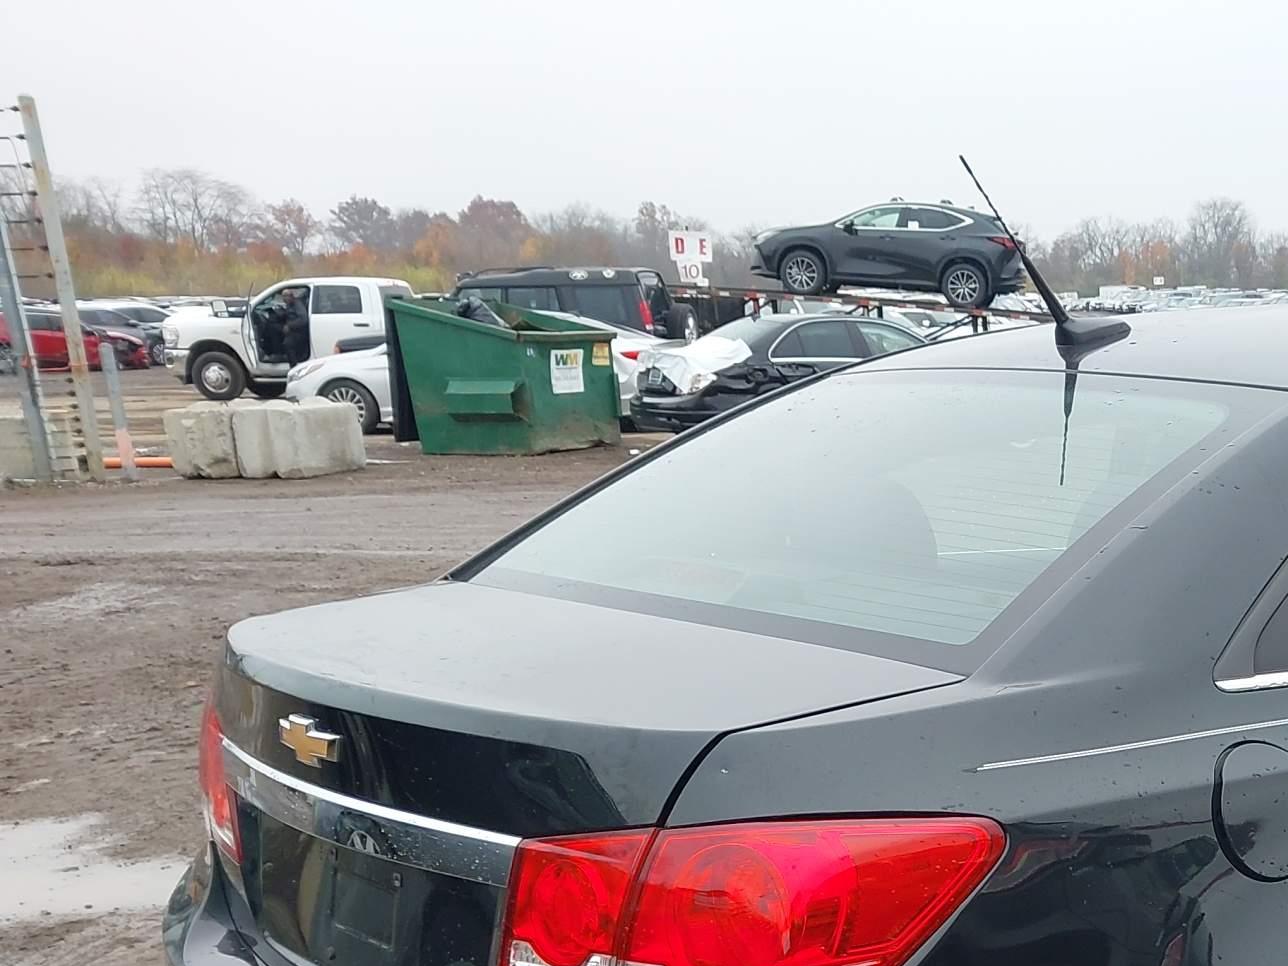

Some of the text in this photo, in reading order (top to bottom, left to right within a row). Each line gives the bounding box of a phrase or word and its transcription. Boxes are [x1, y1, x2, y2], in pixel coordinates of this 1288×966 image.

[675, 238, 707, 255] D E
[682, 264, 699, 279] 10
[555, 353, 578, 366] WM
